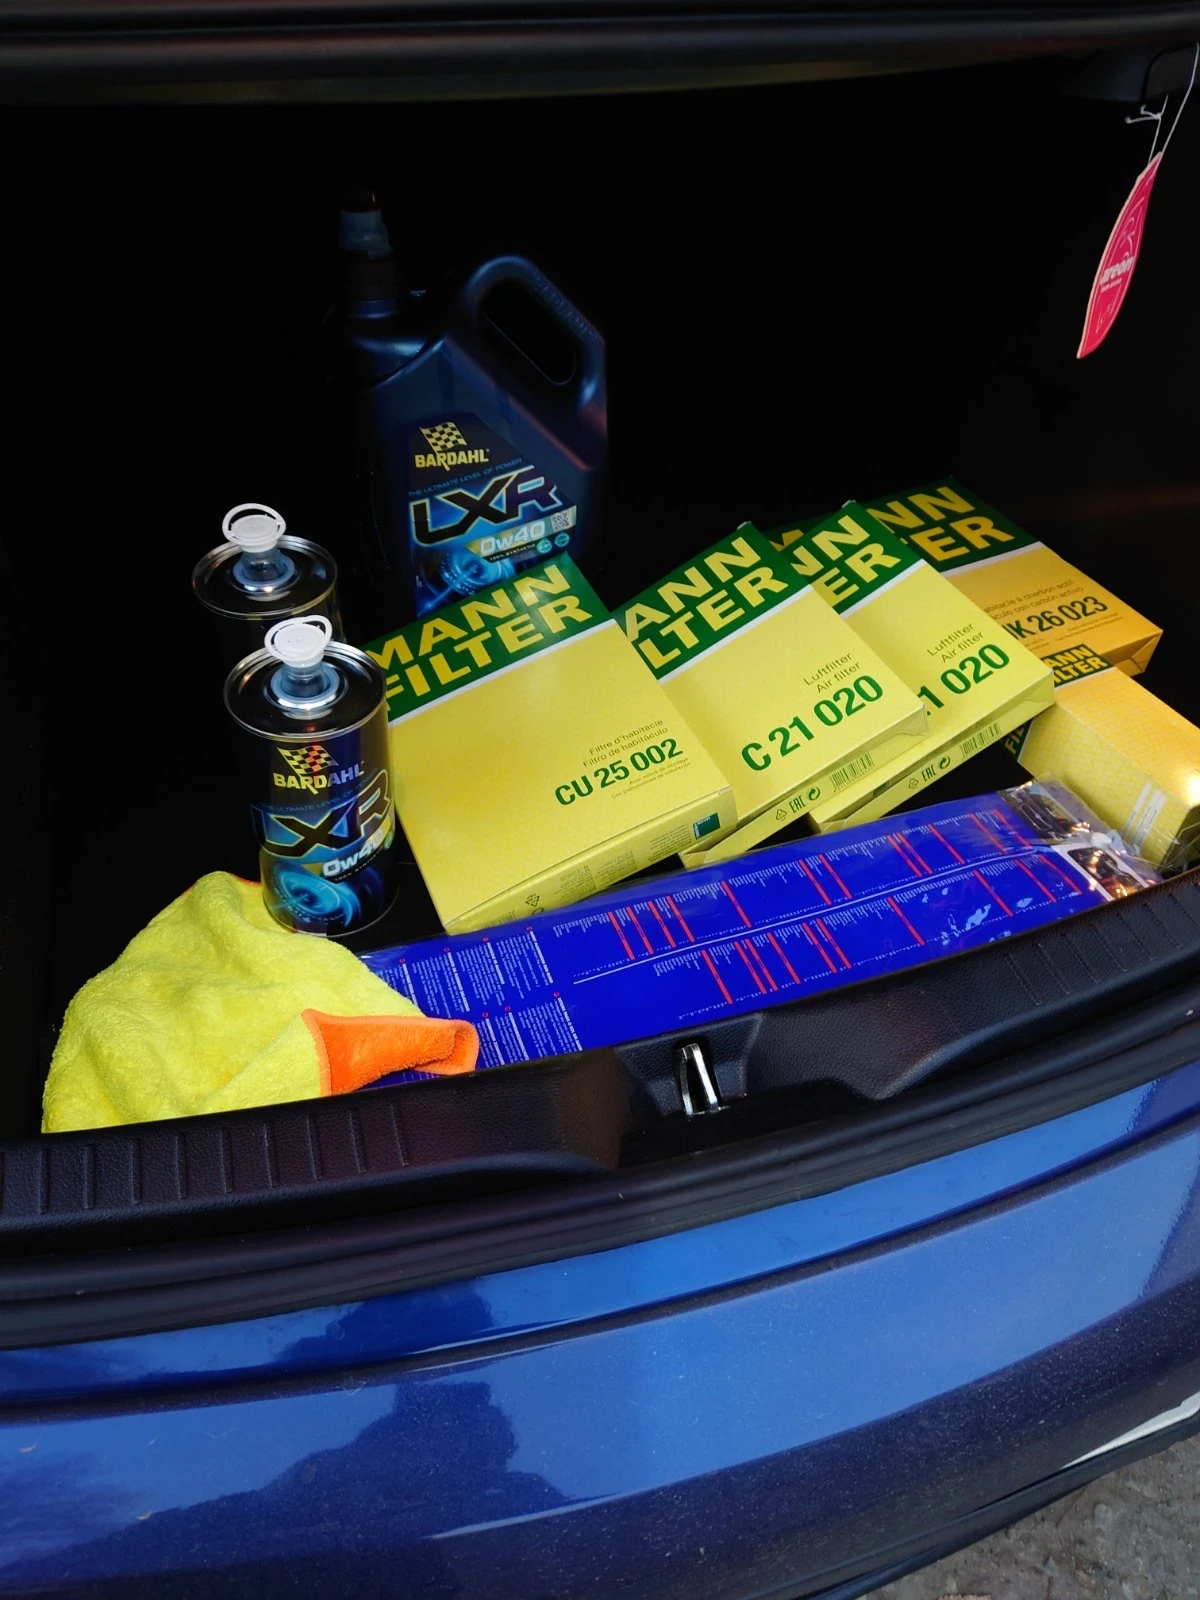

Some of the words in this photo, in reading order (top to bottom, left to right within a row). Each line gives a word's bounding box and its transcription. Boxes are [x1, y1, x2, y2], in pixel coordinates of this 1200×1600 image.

[415, 449, 489, 471] BARDAHL
[409, 464, 563, 546] LXR
[625, 536, 761, 642] ANN
[637, 566, 788, 670] LTER
[1027, 610, 1065, 632] 26
[1058, 596, 1108, 620] 023
[927, 622, 974, 657] Luftfilter
[940, 648, 958, 663] Air
[958, 630, 985, 654] filter
[804, 652, 853, 686] Luftfilter
[940, 643, 1010, 695] 020
[1043, 646, 1094, 668] ANN
[816, 677, 834, 693] Air
[834, 661, 861, 684] filter
[741, 742, 771, 771] C
[769, 716, 815, 757] 21
[813, 675, 884, 727] 020
[582, 754, 607, 768] Filtro
[608, 748, 620, 757] de
[589, 741, 613, 755] Filtre
[273, 764, 364, 794] BARDAHL
[555, 775, 594, 805] CU
[594, 760, 630, 788] 25
[630, 738, 683, 771] 002
